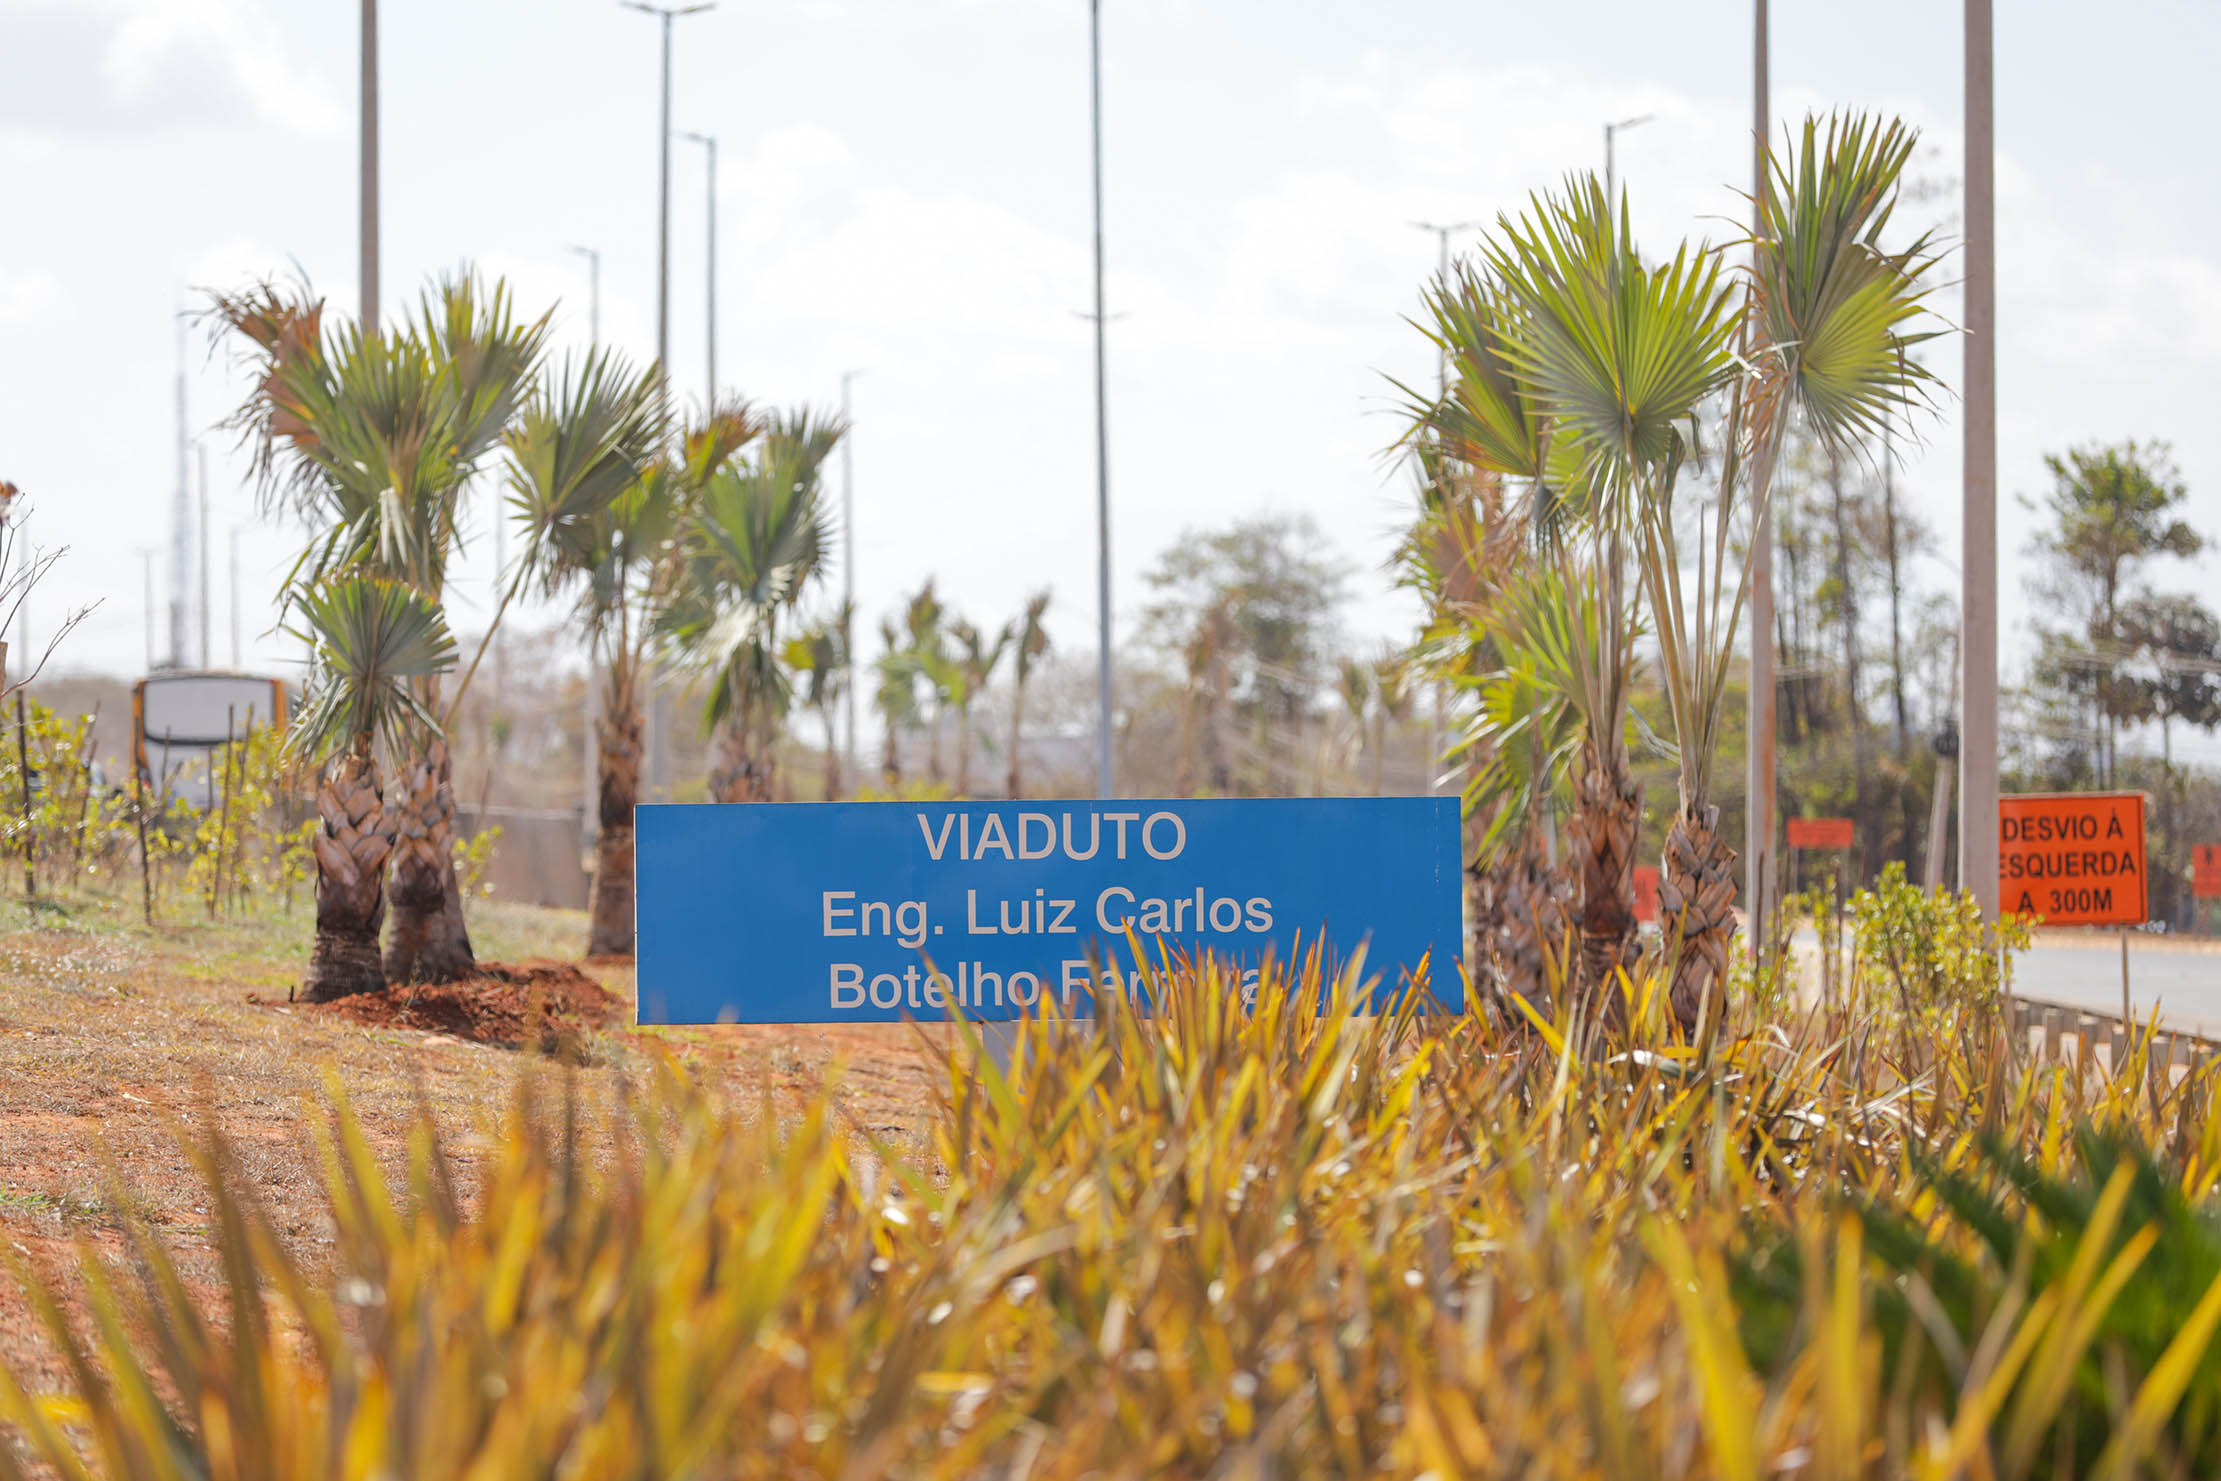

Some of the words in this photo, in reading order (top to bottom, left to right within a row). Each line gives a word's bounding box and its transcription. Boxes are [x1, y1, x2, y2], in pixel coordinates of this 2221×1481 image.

[917, 811, 1187, 861] VIADUTO
[2002, 815, 2098, 842] DESVIO
[2107, 808, 2124, 839] À
[823, 891, 944, 949] Eng.
[968, 888, 1077, 935] Luiz
[1096, 886, 1273, 934] Carlos
[2018, 890, 2035, 914] A
[2050, 888, 2113, 914] 300M
[830, 961, 1040, 1009] Botelho
